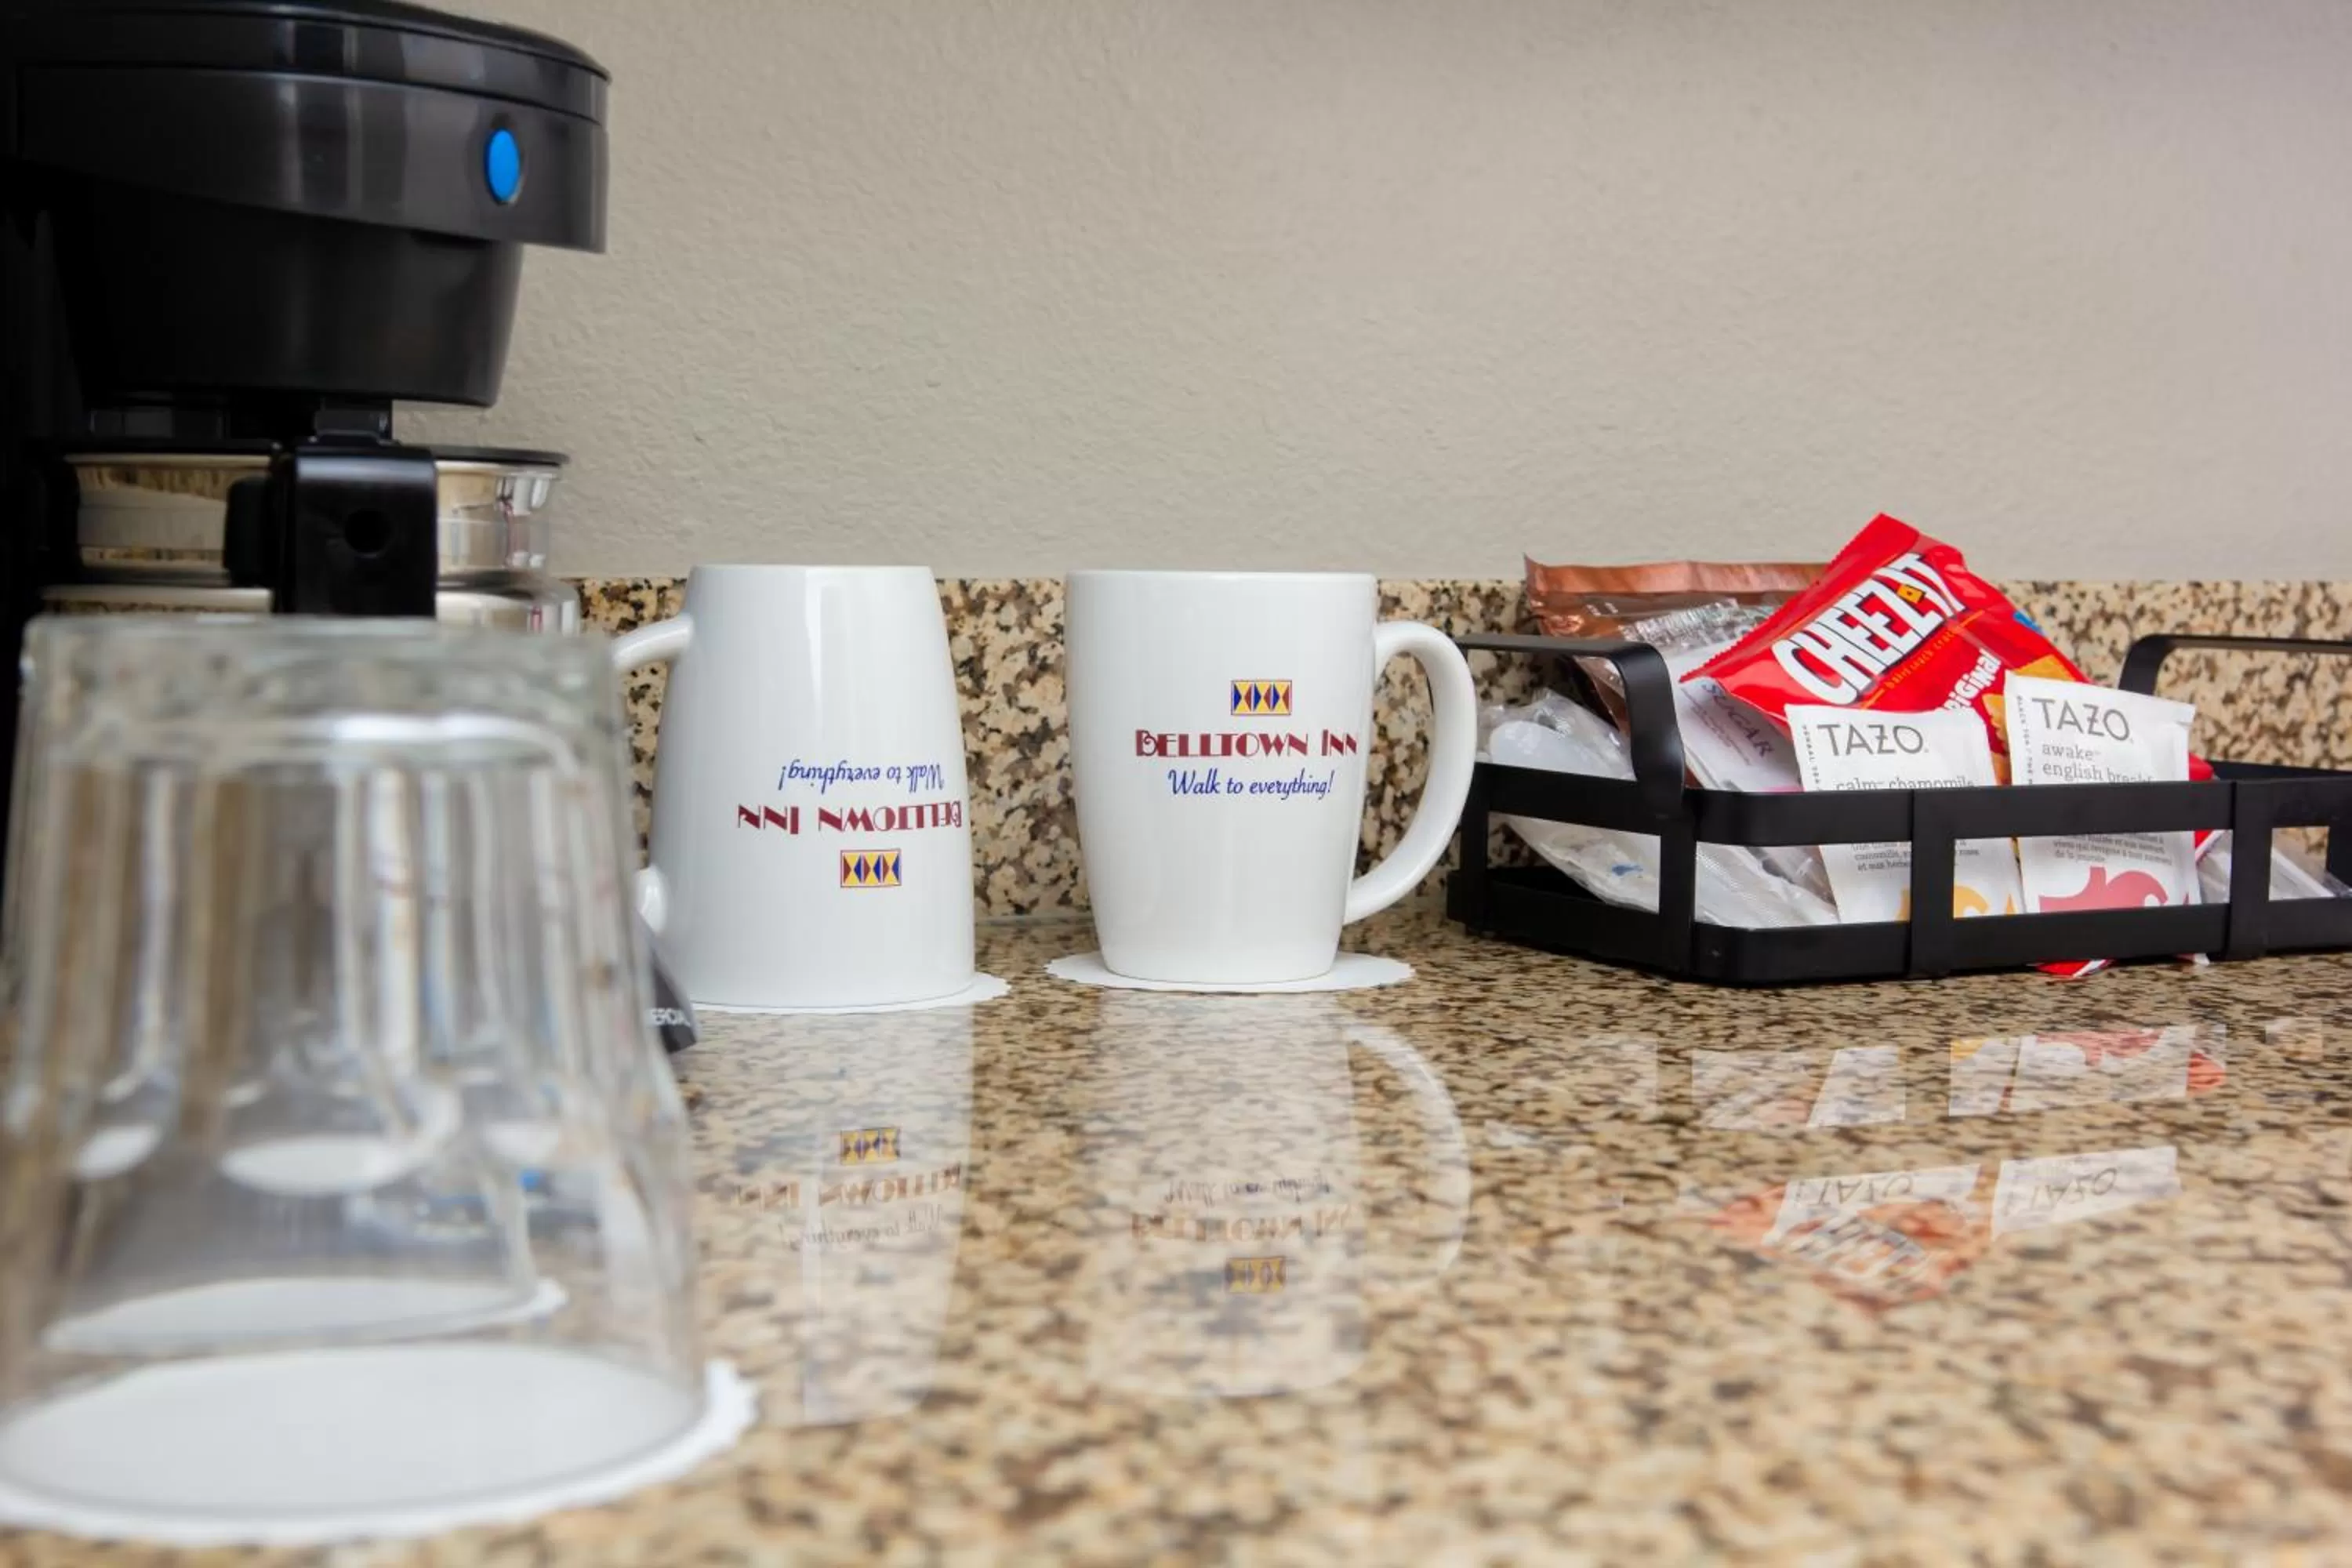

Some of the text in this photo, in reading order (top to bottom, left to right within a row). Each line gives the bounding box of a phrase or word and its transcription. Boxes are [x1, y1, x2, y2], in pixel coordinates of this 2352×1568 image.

[1943, 648, 2002, 710] RiGiNal
[2031, 697, 2130, 741] TAZO
[1135, 728, 1358, 758] BELLTOWN INN
[1817, 724, 1924, 757] TAZO
[778, 759, 944, 793] Walk to everything!
[1167, 768, 1335, 800] Walk to everything!
[2042, 762, 2103, 782] english
[738, 800, 963, 835] BELLTOWN INN
